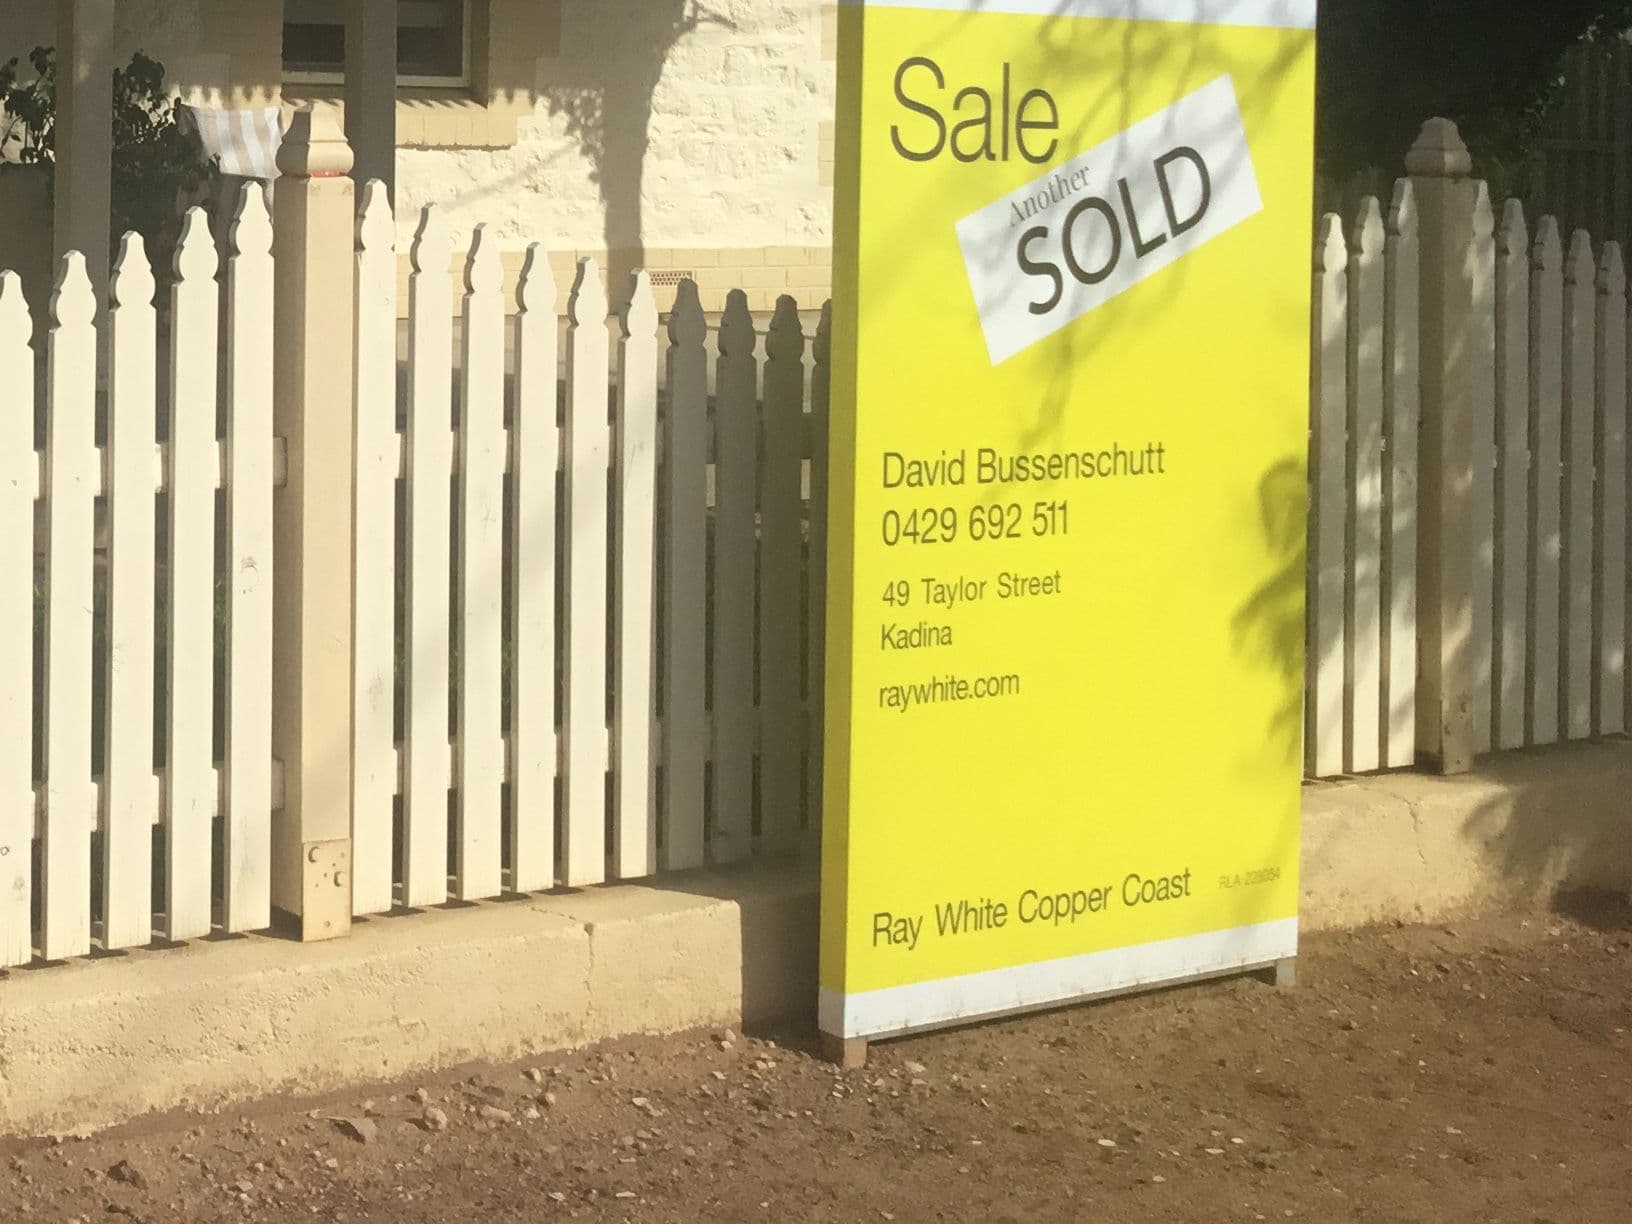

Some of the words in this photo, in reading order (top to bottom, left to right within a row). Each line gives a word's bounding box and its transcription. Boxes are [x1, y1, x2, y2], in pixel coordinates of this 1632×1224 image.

[890, 56, 1059, 164] Sale
[1008, 164, 1091, 227] Another
[1016, 145, 1211, 315] SOLD
[882, 449, 966, 489] David
[976, 441, 1165, 484] Bussenschutt
[881, 506, 958, 546] 0429
[968, 503, 1022, 541] 692
[1032, 499, 1068, 537] 511
[881, 580, 910, 607] 49
[921, 575, 987, 610] Taylor
[996, 569, 1062, 599] Street
[880, 621, 953, 650] Kadina
[879, 672, 1020, 714] raywhite.com
[872, 911, 923, 951] Ray
[934, 899, 1008, 938] White
[1018, 881, 1113, 928] Copper
[1121, 867, 1191, 907] Coast
